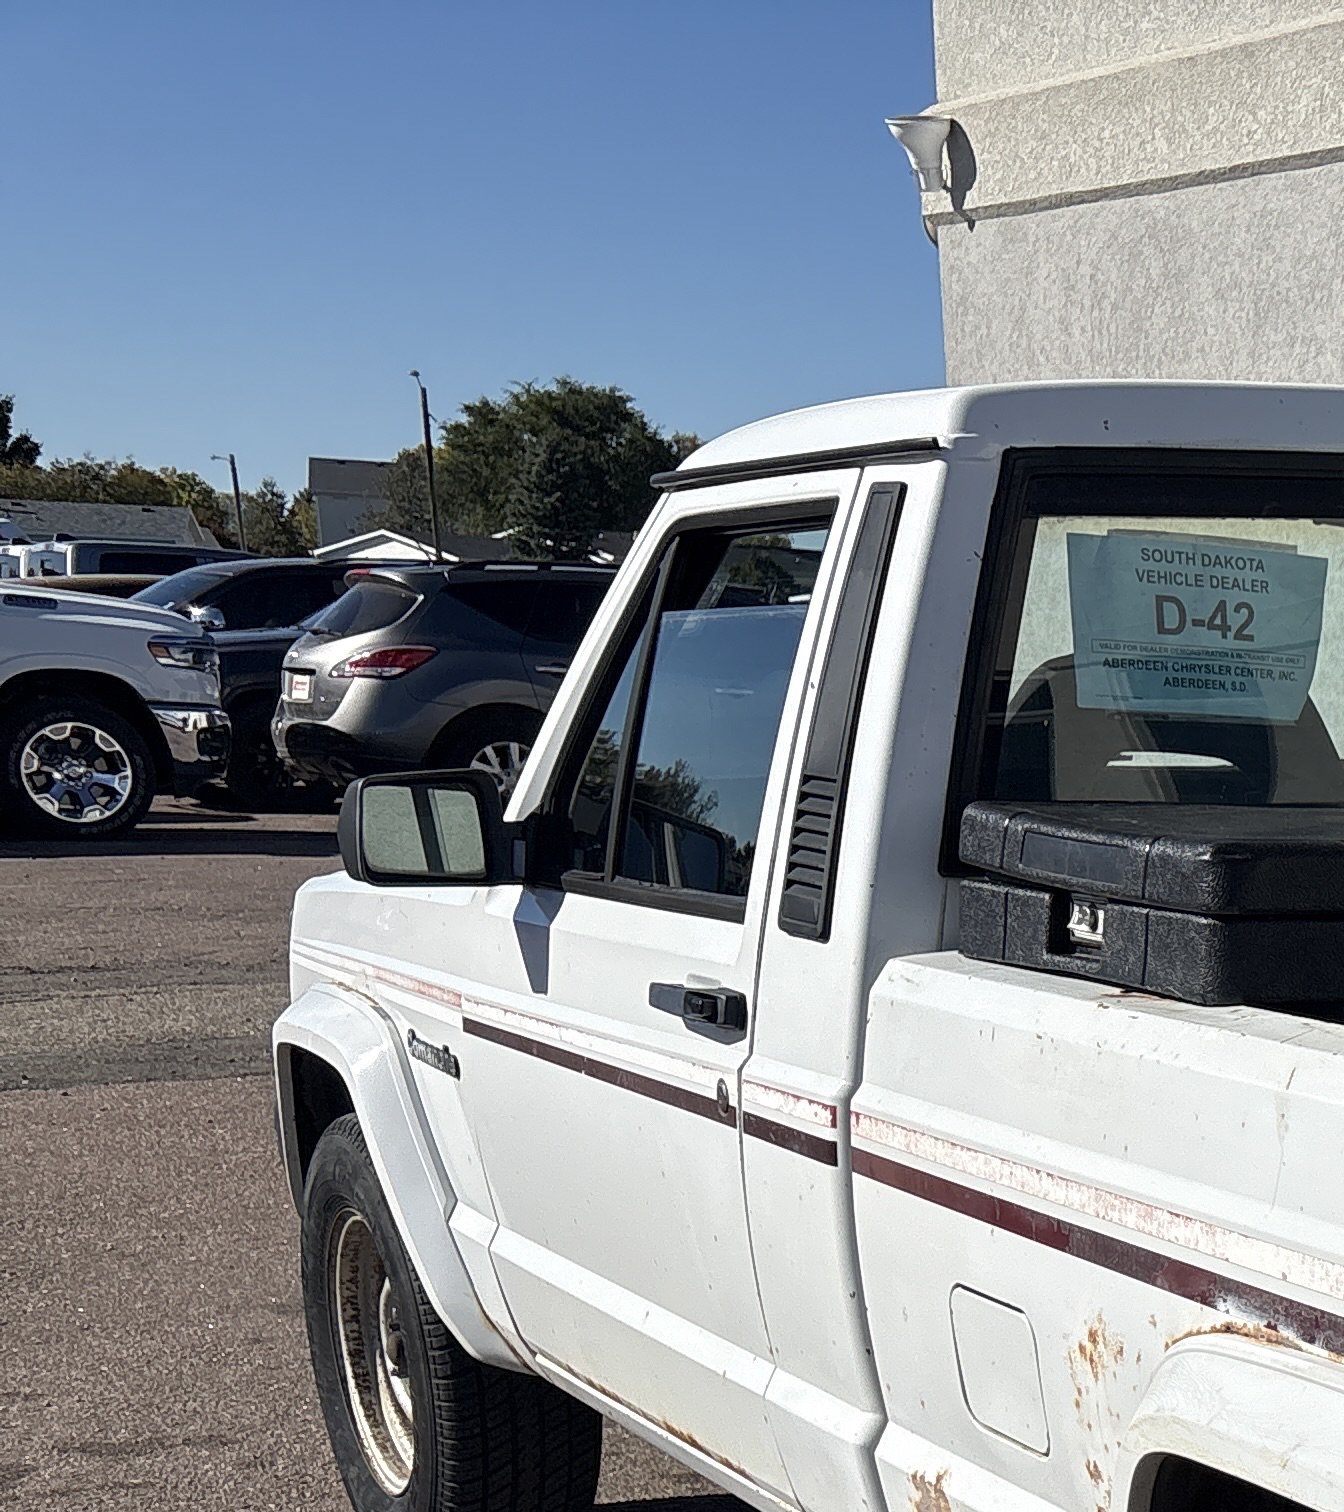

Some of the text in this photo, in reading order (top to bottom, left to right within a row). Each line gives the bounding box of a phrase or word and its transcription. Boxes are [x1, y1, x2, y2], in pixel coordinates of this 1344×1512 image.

[1140, 547, 1266, 573] SOUTH DAKOTA
[1135, 568, 1270, 594] VEHICLE DEALER
[1155, 594, 1255, 642] D-42
[1123, 643, 1138, 653] FOR
[1102, 657, 1298, 682] ABERDEEN CHRYSLER CENTER, INC.
[1163, 676, 1249, 693] ABERDEEN, S.D.
